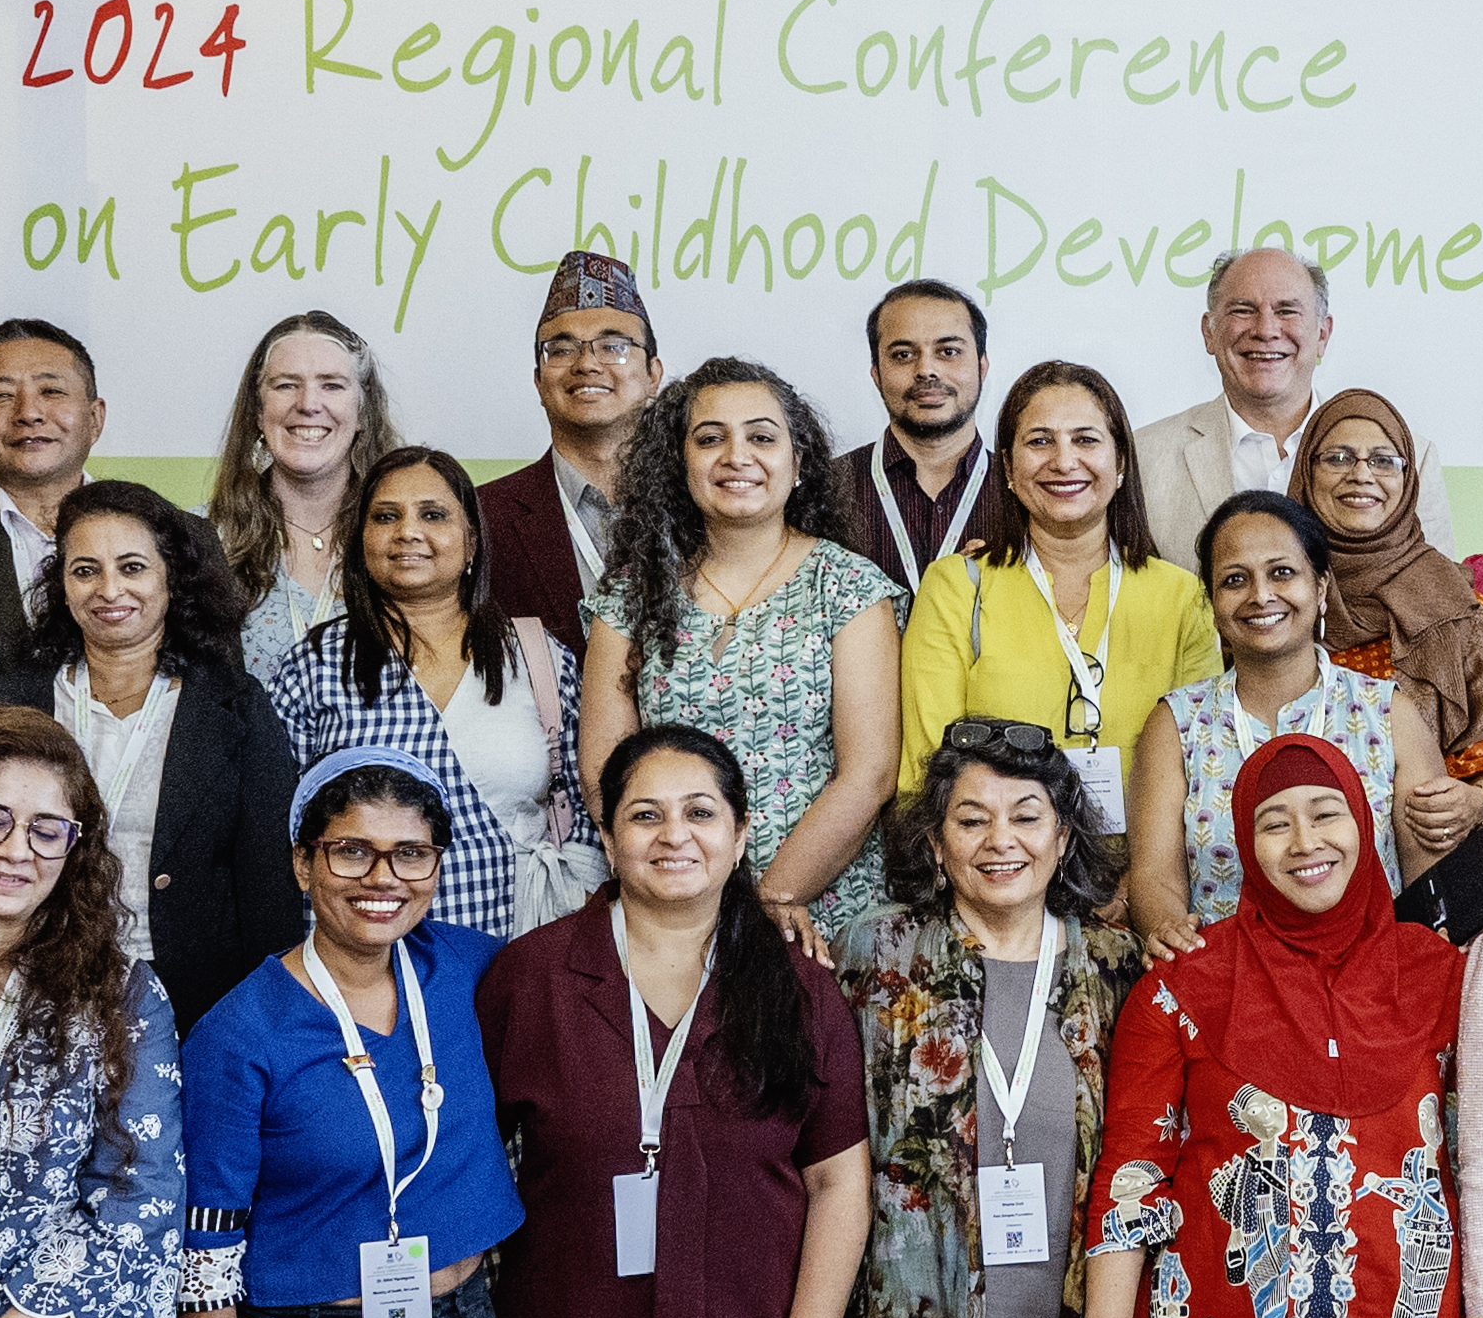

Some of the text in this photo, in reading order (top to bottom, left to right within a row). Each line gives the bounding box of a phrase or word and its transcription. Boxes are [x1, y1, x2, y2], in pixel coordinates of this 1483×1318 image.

[22, 196, 121, 281] on
[170, 154, 442, 334] Early
[491, 154, 939, 293] Childhood
